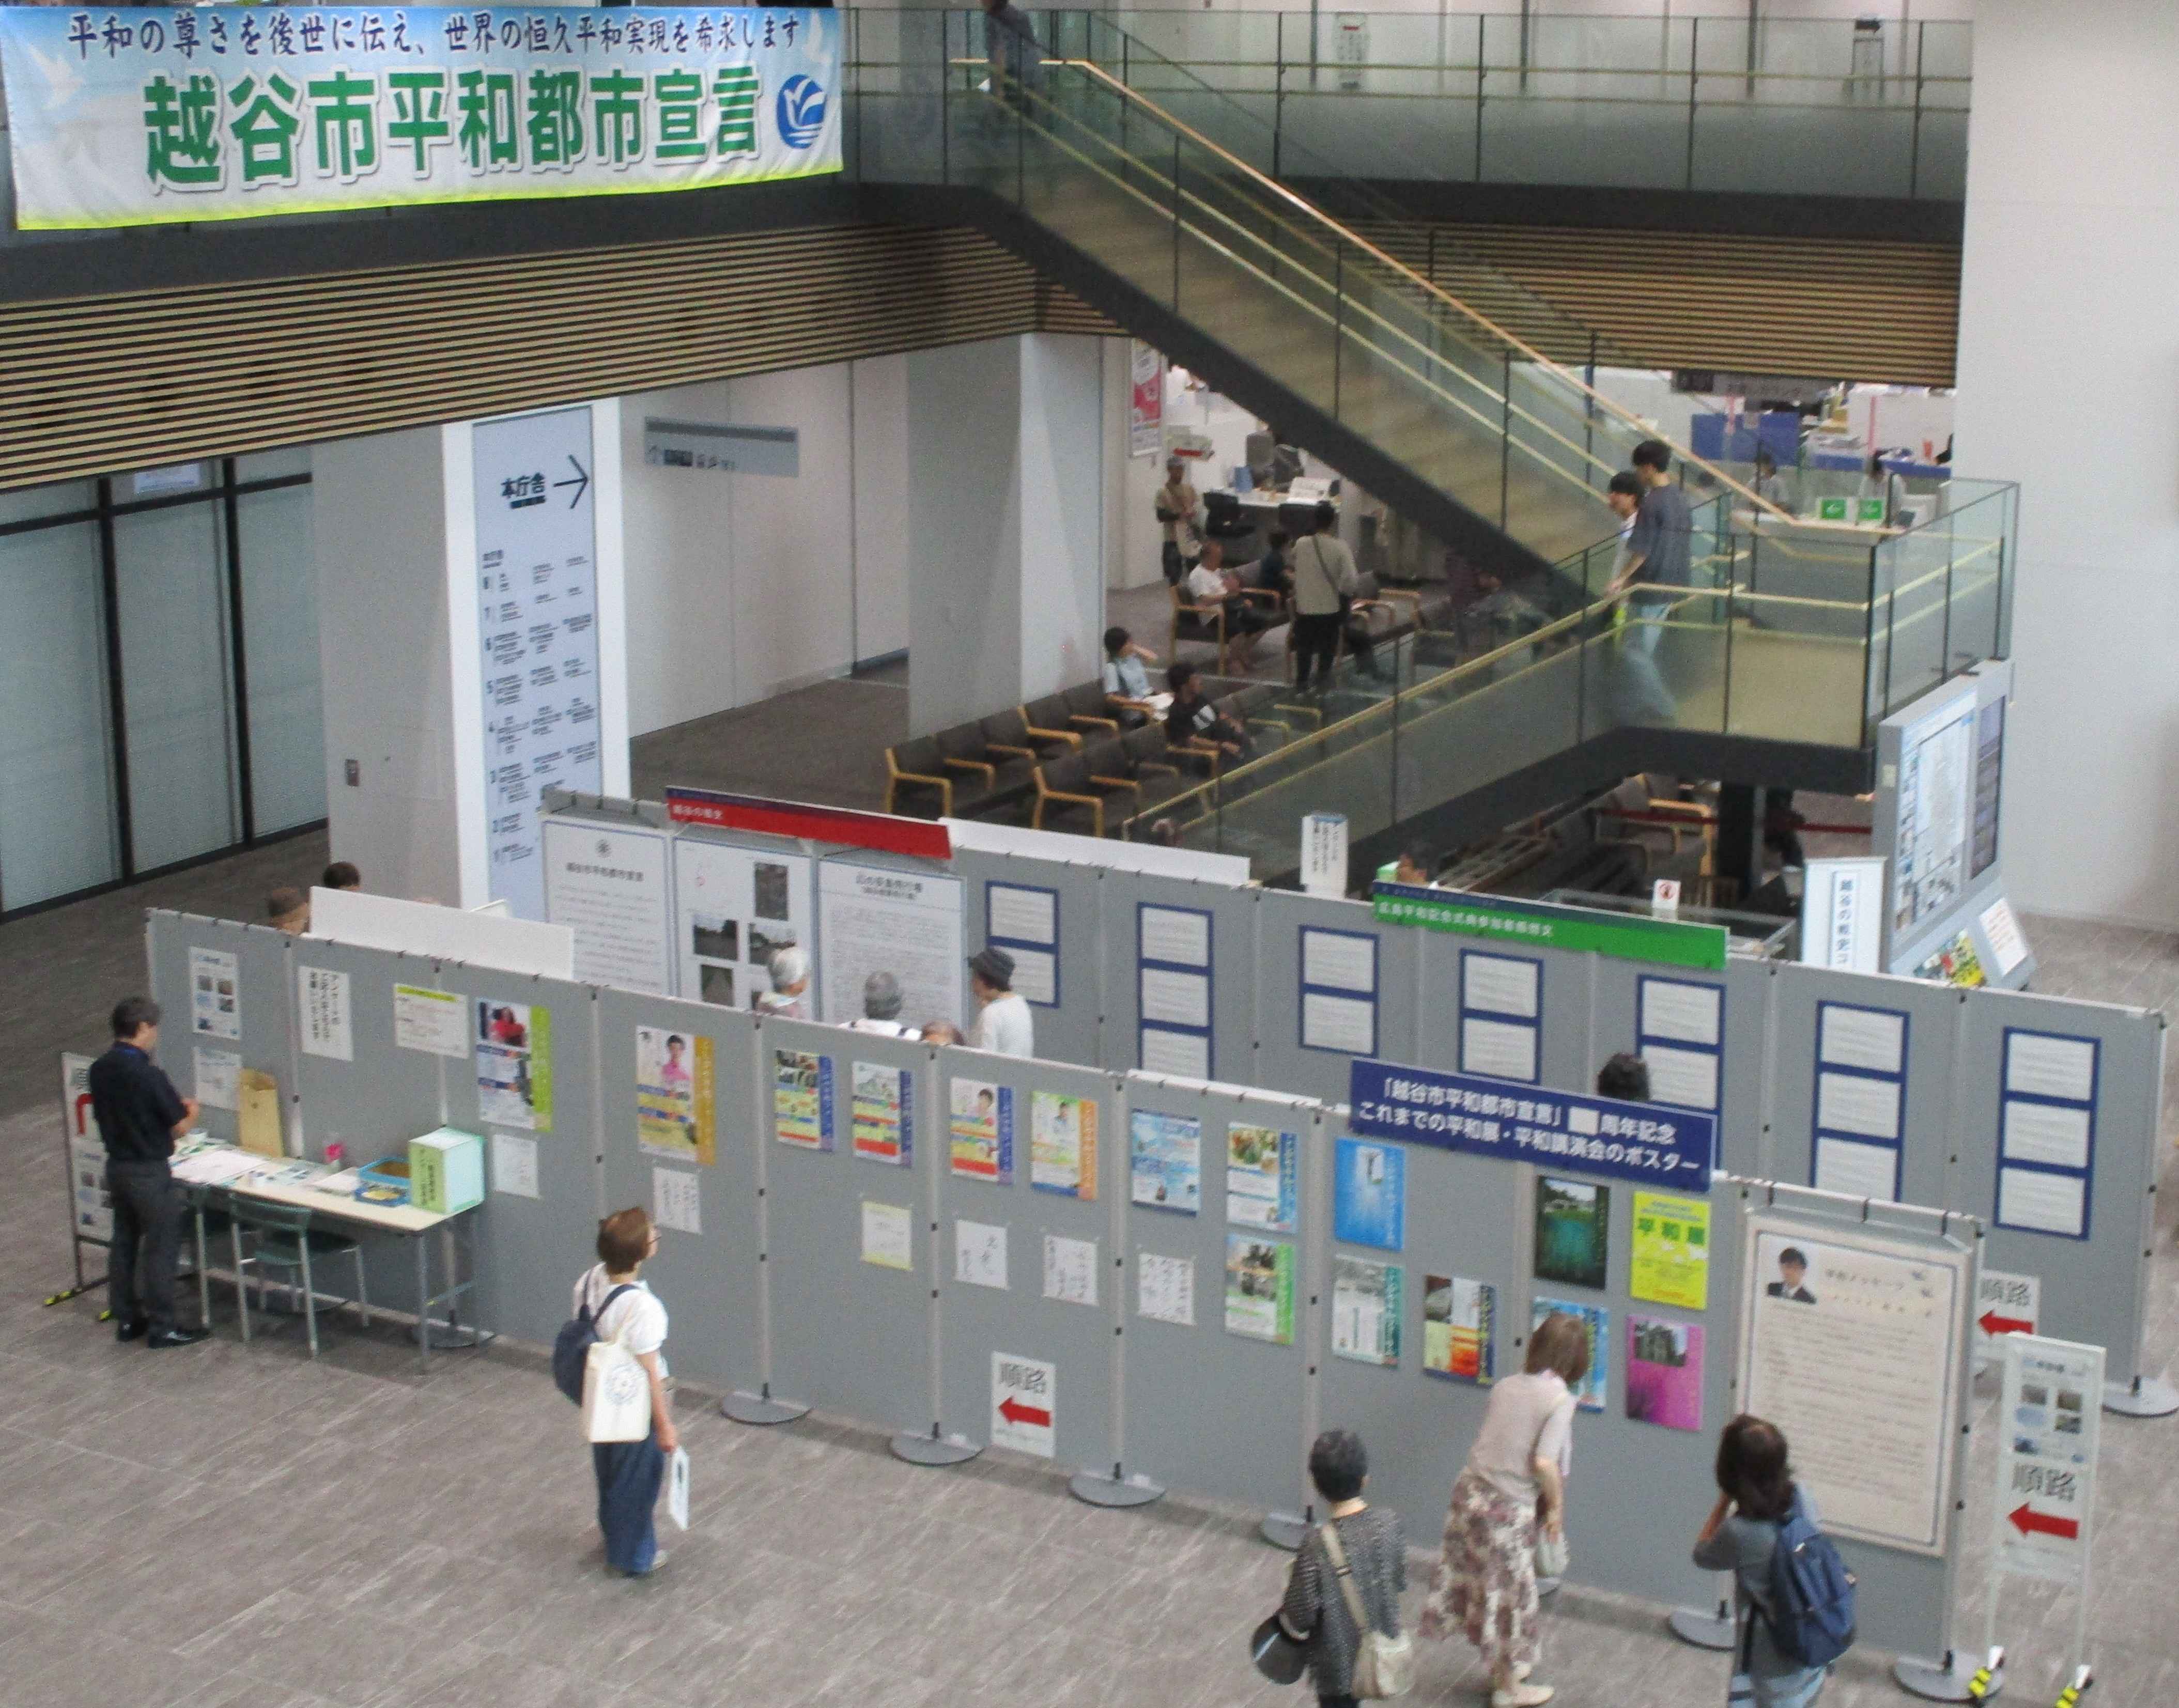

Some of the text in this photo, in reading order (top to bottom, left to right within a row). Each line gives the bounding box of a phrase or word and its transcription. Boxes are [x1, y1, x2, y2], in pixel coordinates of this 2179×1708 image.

[144, 65, 760, 183] 越谷市平和都市宣言
[501, 472, 545, 499] 本庁舎
[1980, 1279, 2030, 1307] 順路
[999, 1362, 1047, 1394] 順路
[2012, 1463, 2076, 1502] 順路
